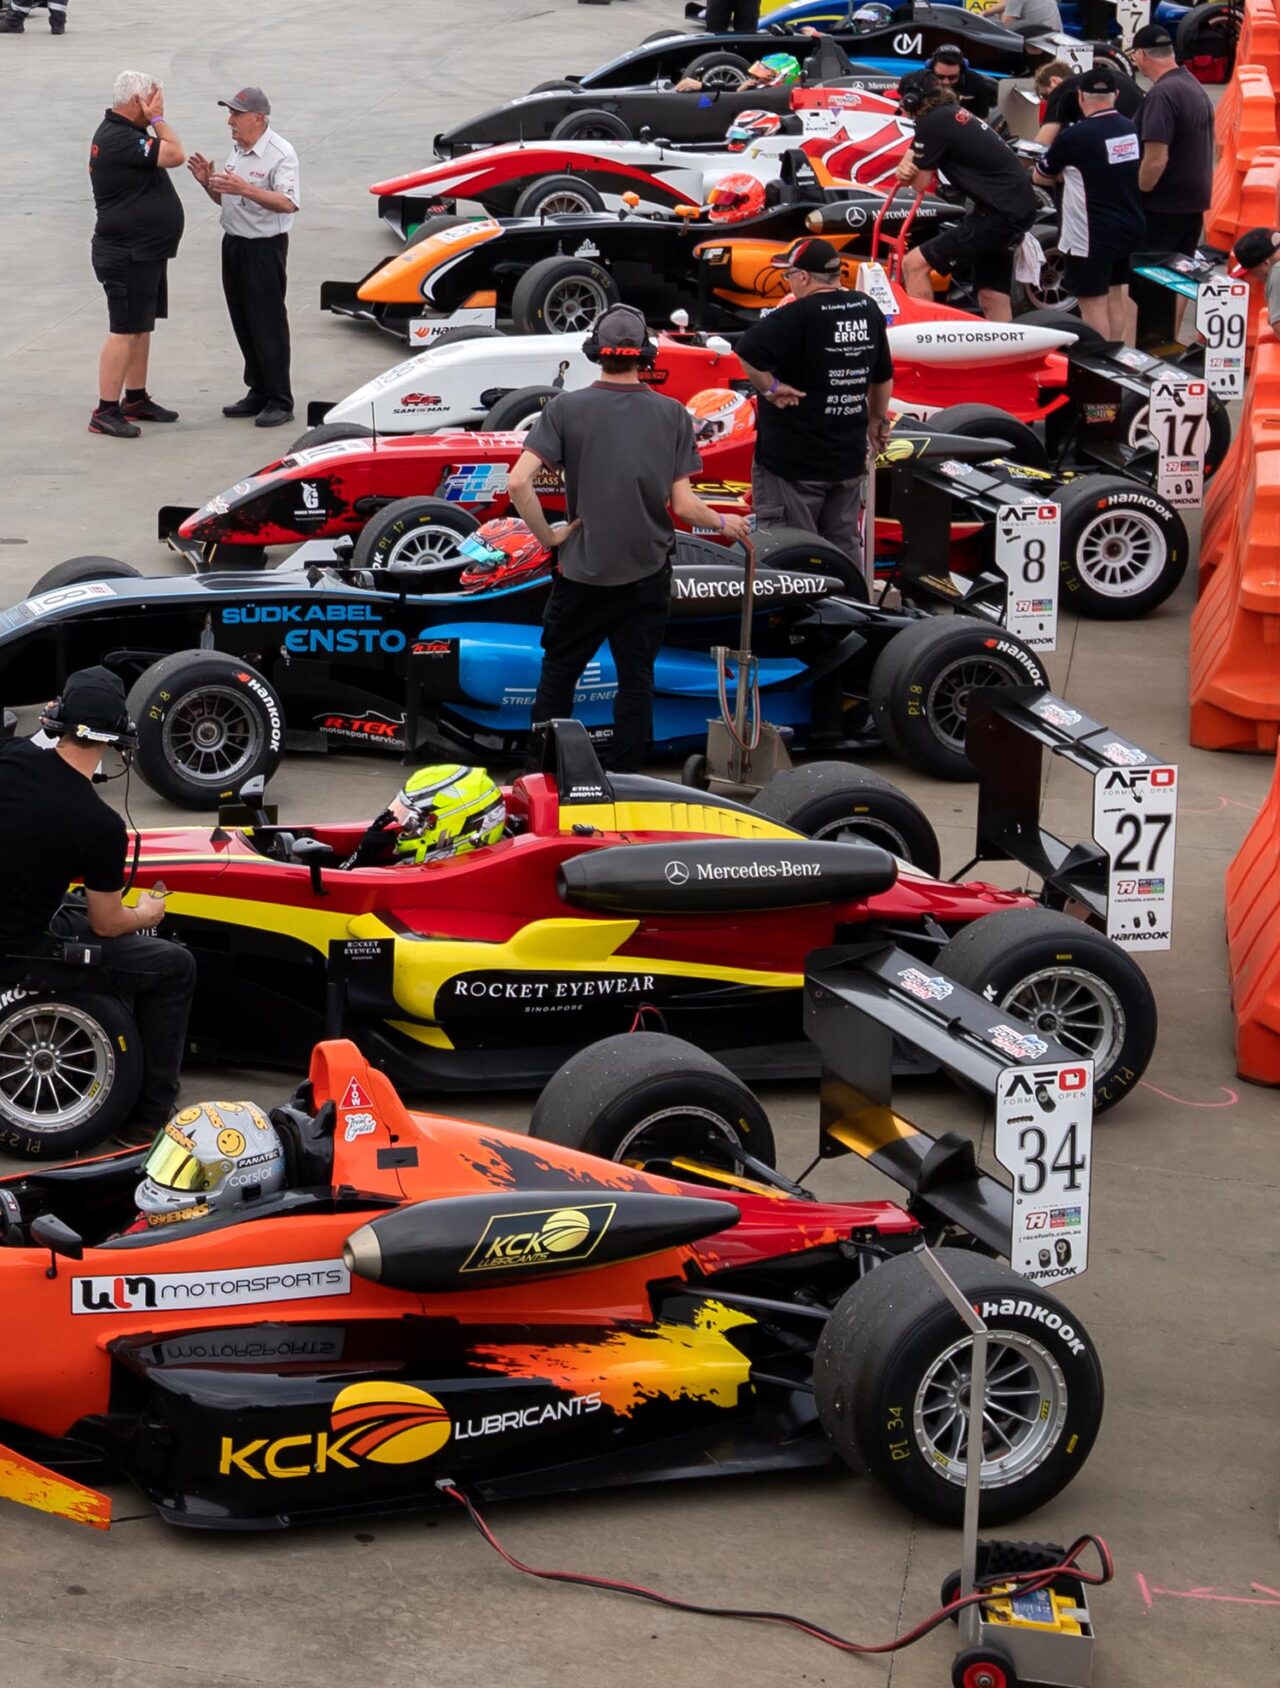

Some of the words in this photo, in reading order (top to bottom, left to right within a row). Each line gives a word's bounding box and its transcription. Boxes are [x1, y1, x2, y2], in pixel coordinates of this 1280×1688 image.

[1202, 285, 1246, 296] AFO
[836, 319, 868, 332] TEAM
[1206, 314, 1246, 349] 99
[834, 331, 870, 343] ERROL
[916, 334, 933, 344] 99
[936, 332, 1025, 344] MOTORSPORT
[1156, 383, 1205, 397] AFO
[1163, 413, 1204, 457] 17
[1001, 505, 1057, 522] AFO
[1022, 538, 1046, 583] 8
[222, 603, 383, 624] SÜDKABEL
[284, 628, 407, 653] ENSTO
[412, 643, 450, 652] R-TEK
[319, 726, 369, 741] motorsport
[370, 733, 406, 747] services
[323, 715, 400, 737] R-TEK
[1104, 768, 1175, 789] AFO
[1112, 813, 1173, 873] 27
[696, 860, 821, 880] Mercedes-Benz
[344, 947, 382, 955] EYEWEAR
[346, 940, 379, 948] ROCKET
[455, 980, 548, 999] ROCKET
[555, 975, 655, 998] EYEWEAR
[524, 1004, 584, 1013] SINGAPORE
[1005, 1067, 1087, 1098] AFO
[350, 1083, 361, 1106] TOW
[1003, 1096, 1038, 1106] FORMU
[1057, 1091, 1087, 1100] OPEN
[238, 1149, 280, 1168] FANATEC
[1018, 1121, 1087, 1195] 34
[484, 1231, 545, 1259] KCK
[1022, 1229, 1082, 1241] racefuels.com.au
[476, 1251, 550, 1268] LUBRICANTS
[161, 1269, 343, 1299] MOTORSPORTS
[454, 1391, 602, 1441] LUBRICANTS
[887, 1406, 905, 1430] 34
[219, 1430, 362, 1480] KCK
